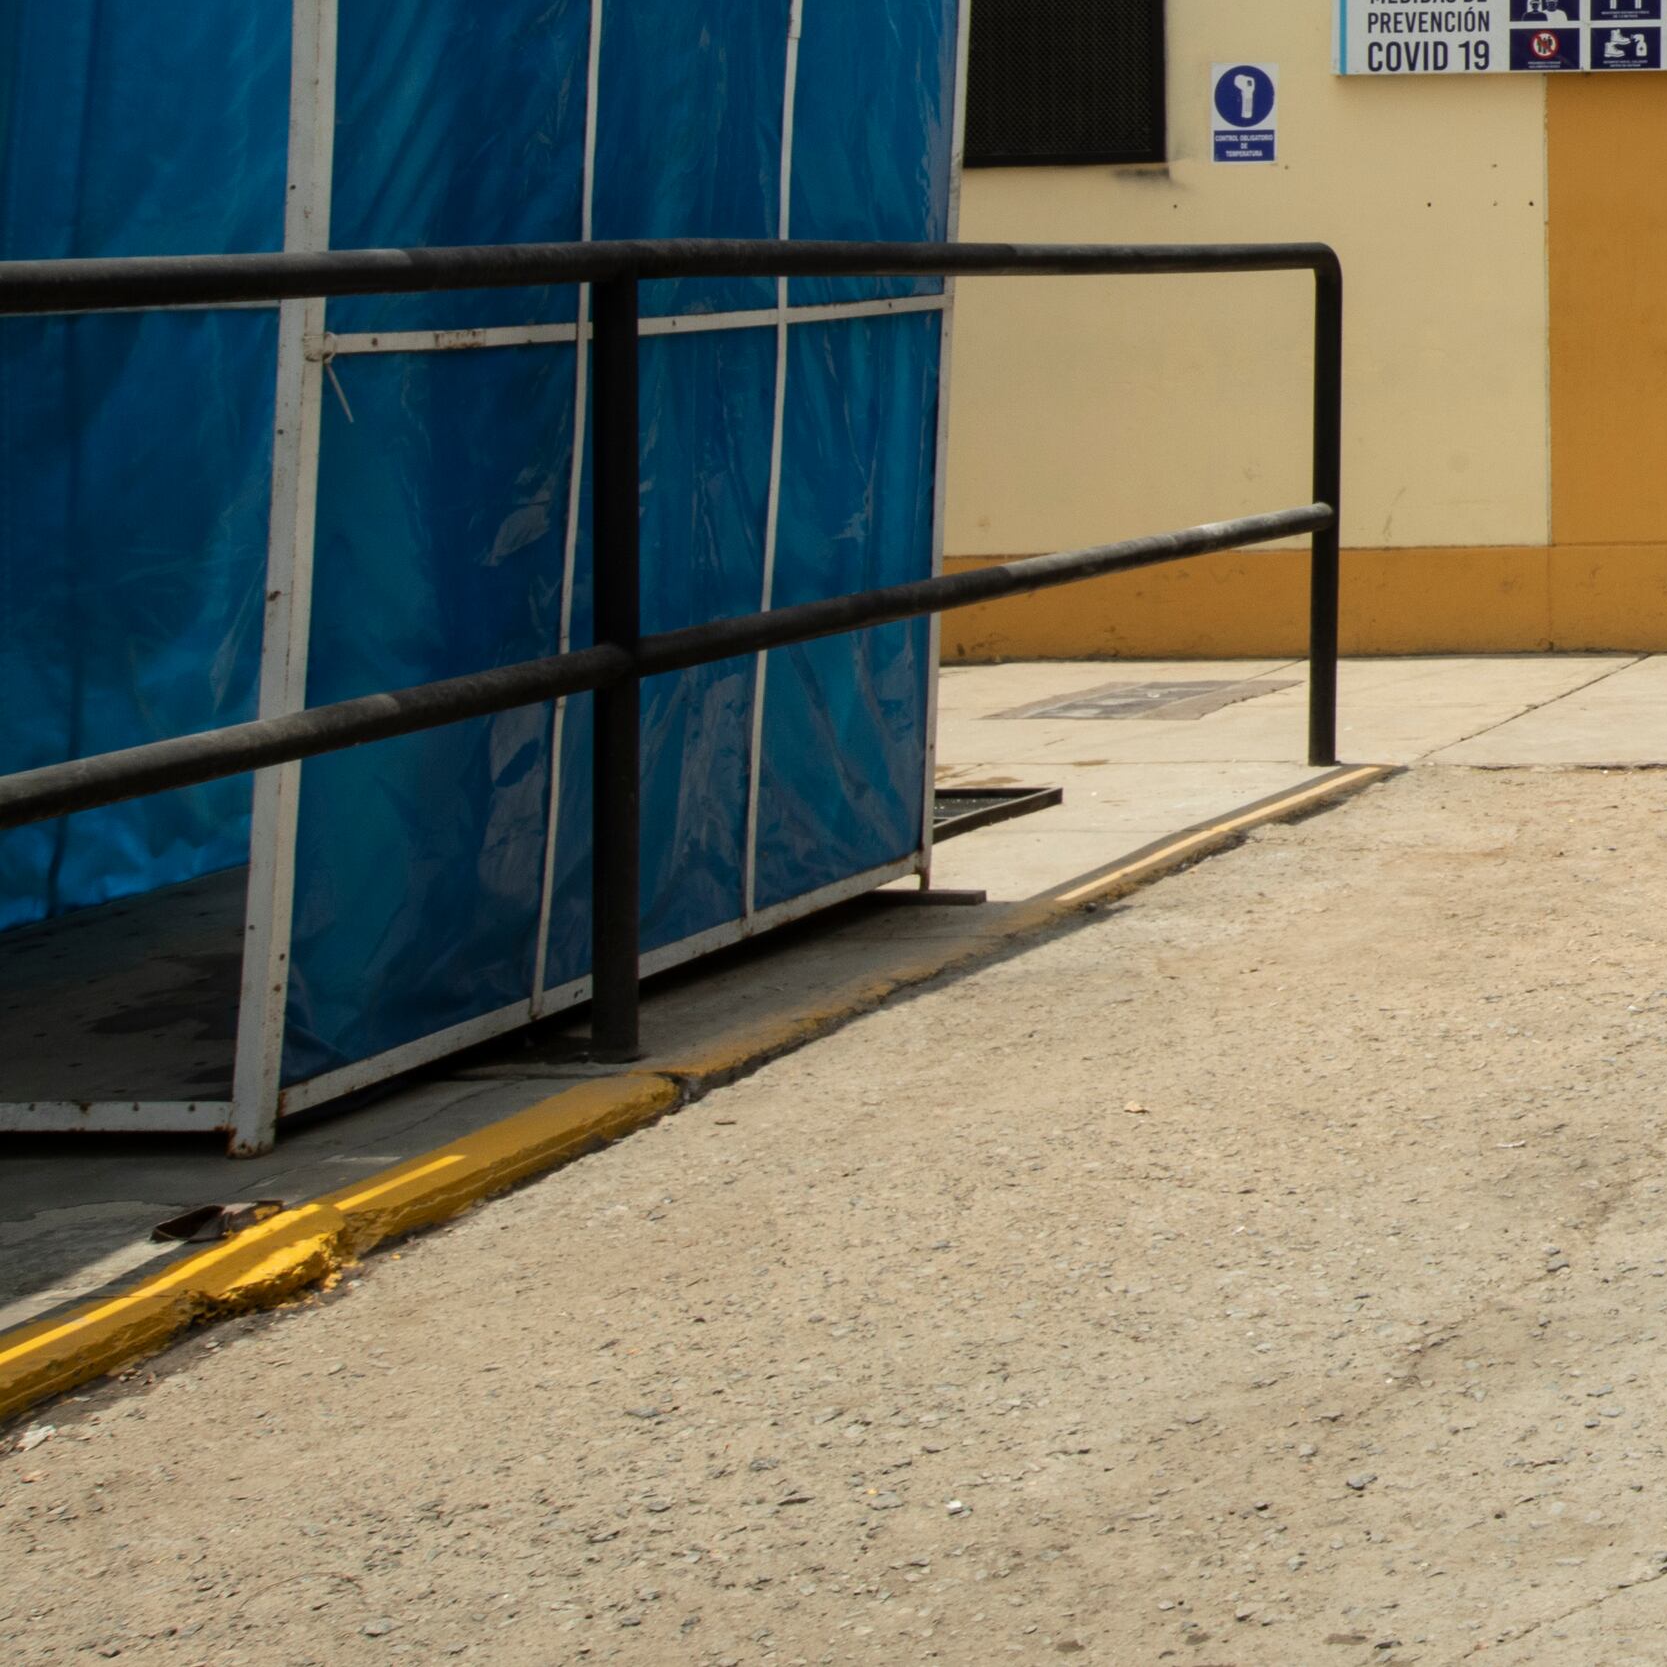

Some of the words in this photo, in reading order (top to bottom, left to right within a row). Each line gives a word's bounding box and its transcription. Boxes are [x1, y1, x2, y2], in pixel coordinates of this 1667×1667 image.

[1368, 7, 1490, 33] PREVENCIÓN
[1368, 41, 1448, 77] COVID
[1459, 40, 1490, 76] 19
